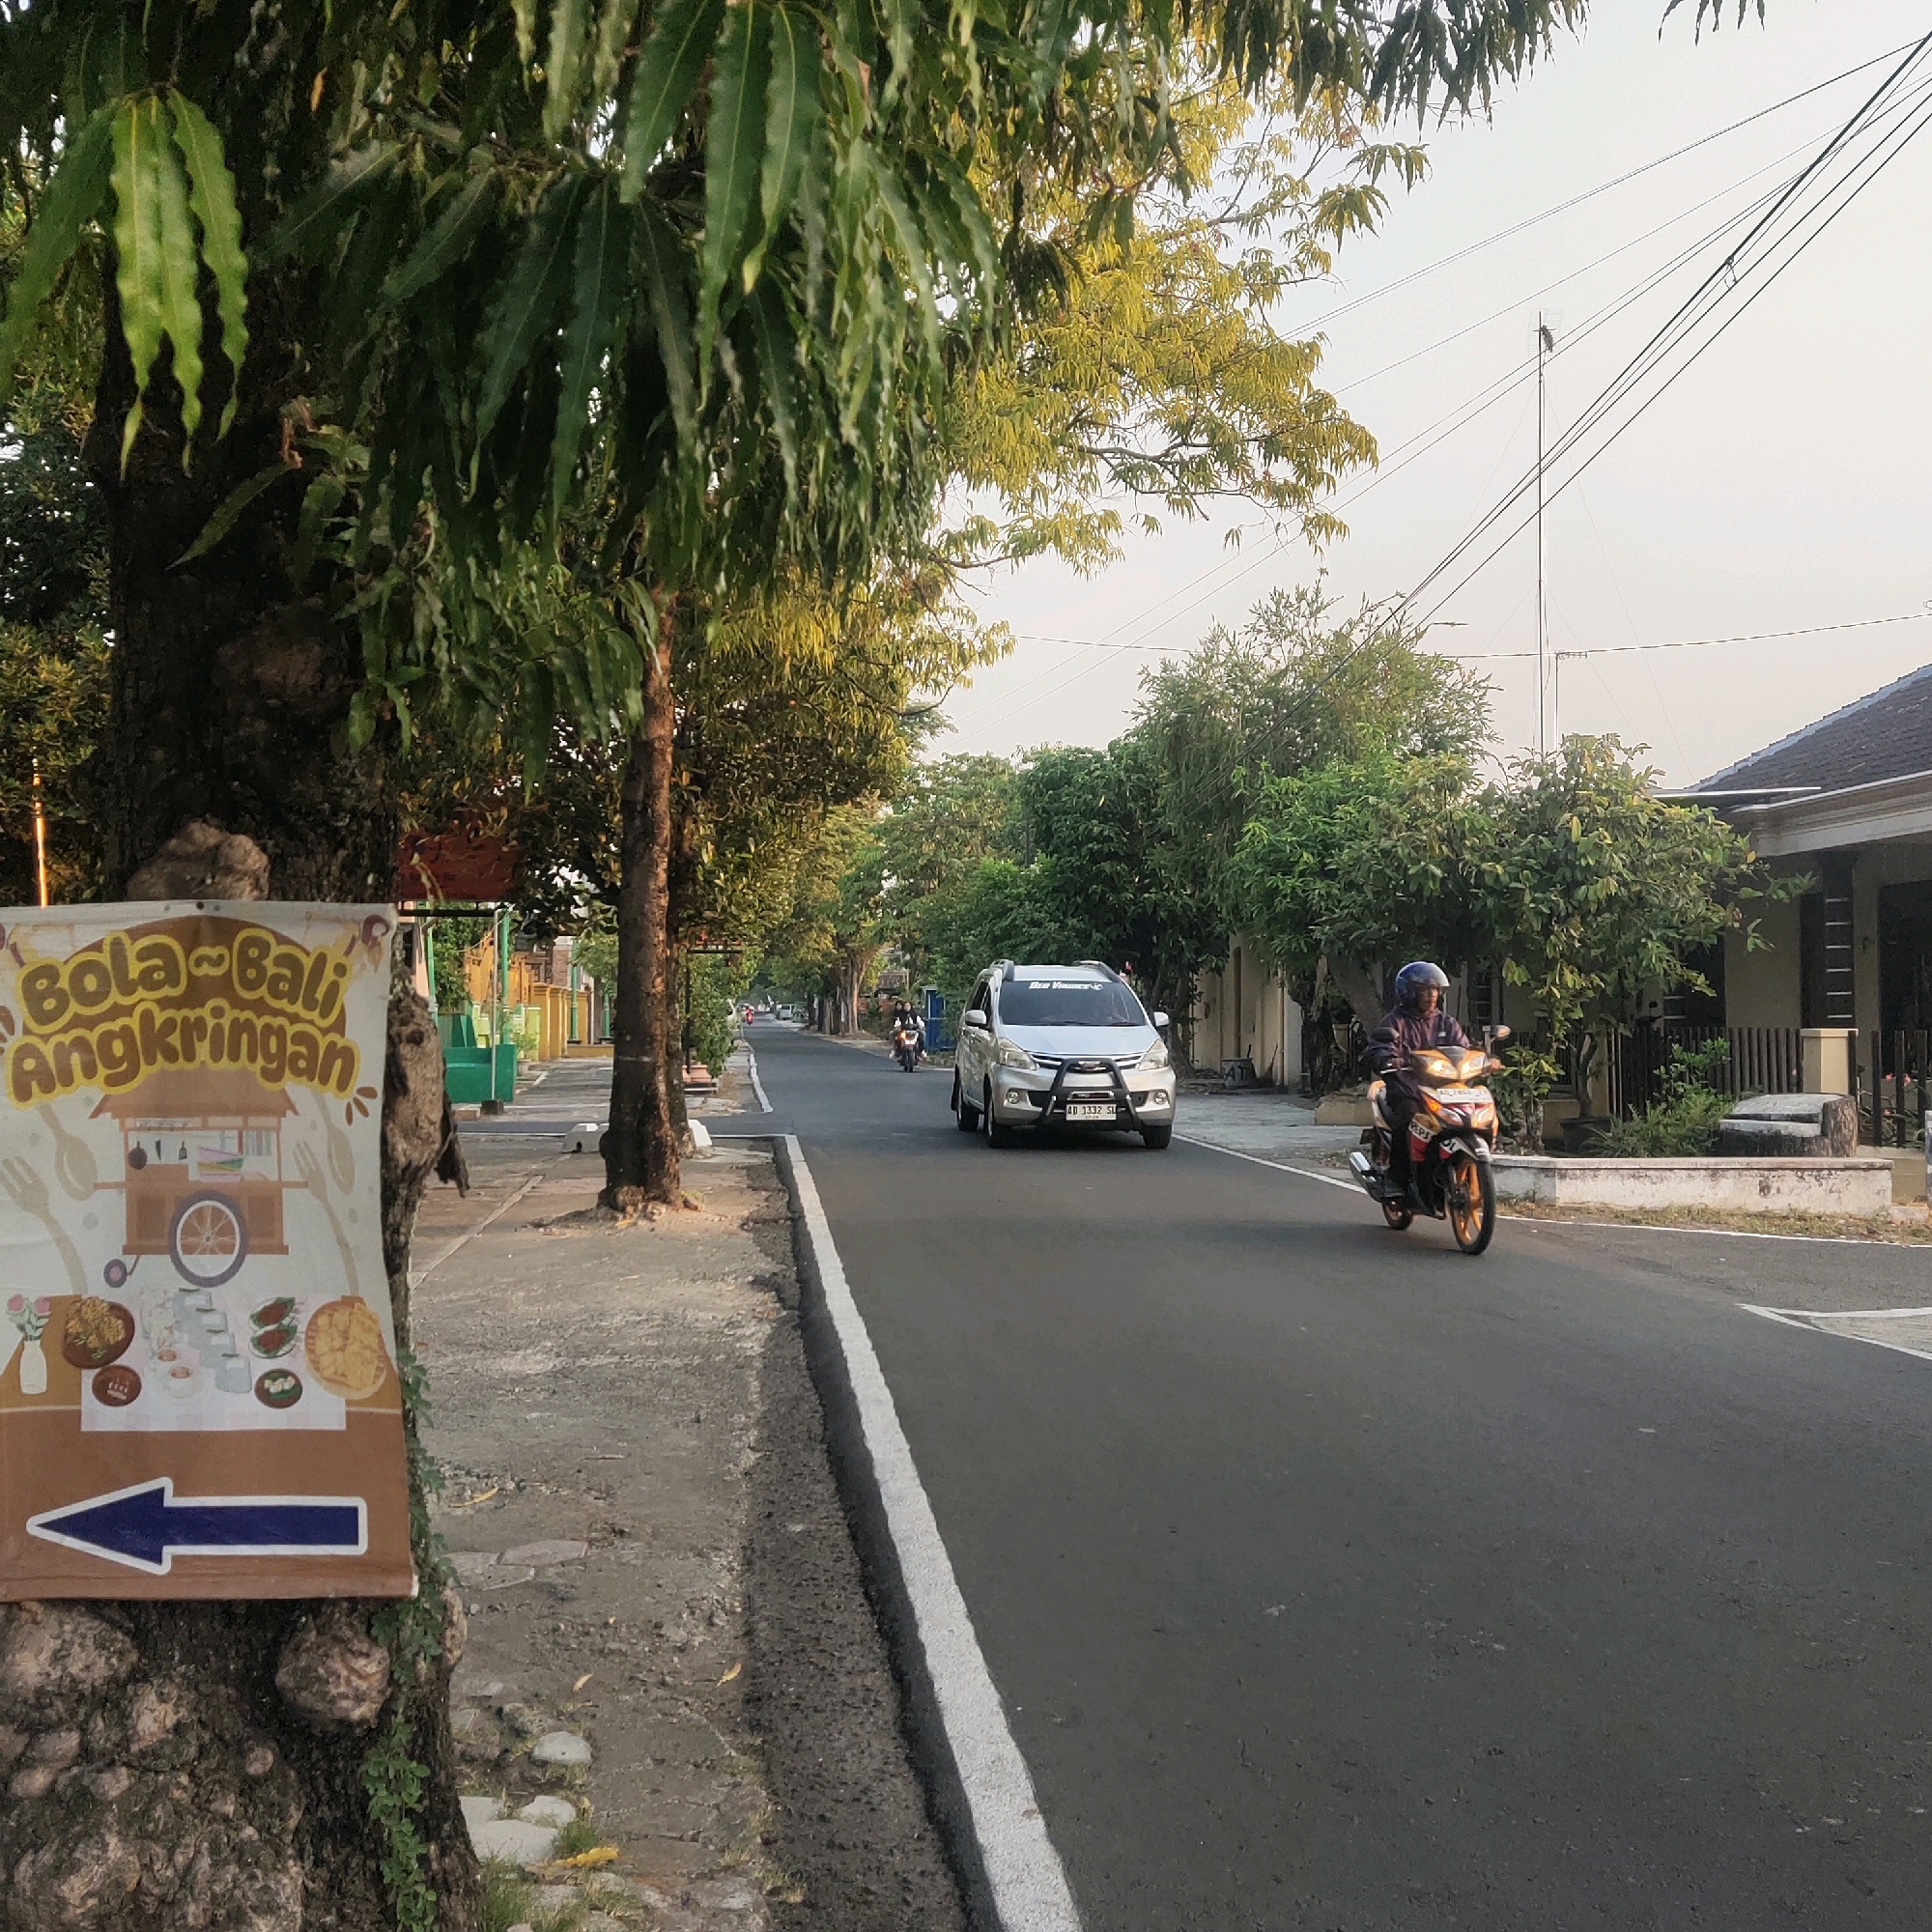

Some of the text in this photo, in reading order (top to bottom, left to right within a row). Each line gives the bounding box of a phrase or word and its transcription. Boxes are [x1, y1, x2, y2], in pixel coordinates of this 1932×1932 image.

[9, 1002, 357, 1106] Angkringan
[1067, 1105, 1078, 1115] AD
[1081, 1105, 1102, 1115] 1332
